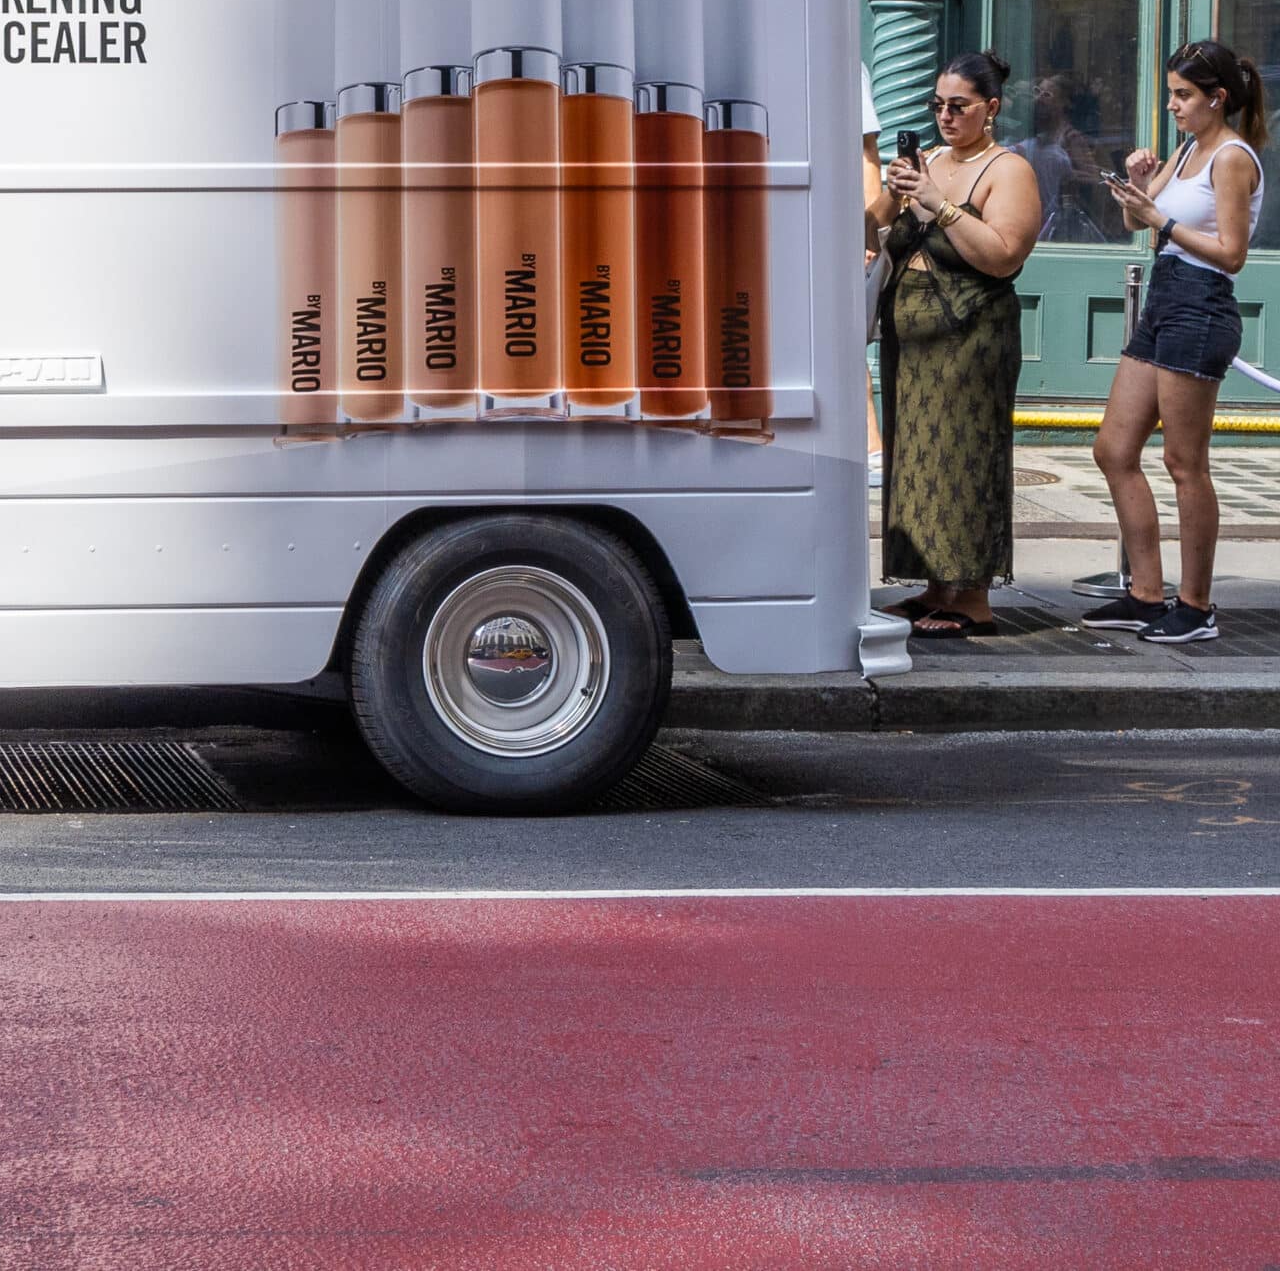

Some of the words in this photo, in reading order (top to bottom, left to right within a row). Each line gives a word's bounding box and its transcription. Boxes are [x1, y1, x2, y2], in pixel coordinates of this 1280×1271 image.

[307, 294, 321, 309] BY
[372, 281, 387, 296] BY
[440, 267, 456, 282] BY
[521, 253, 536, 269] BY
[596, 265, 610, 280] BY
[291, 310, 321, 392] MARIO
[356, 297, 387, 381] MARIO
[425, 284, 457, 370] MARIO
[505, 270, 537, 358] MARIO
[579, 281, 611, 367] MARIO
[651, 295, 682, 379] MARIO
[720, 307, 751, 388] MARIO
